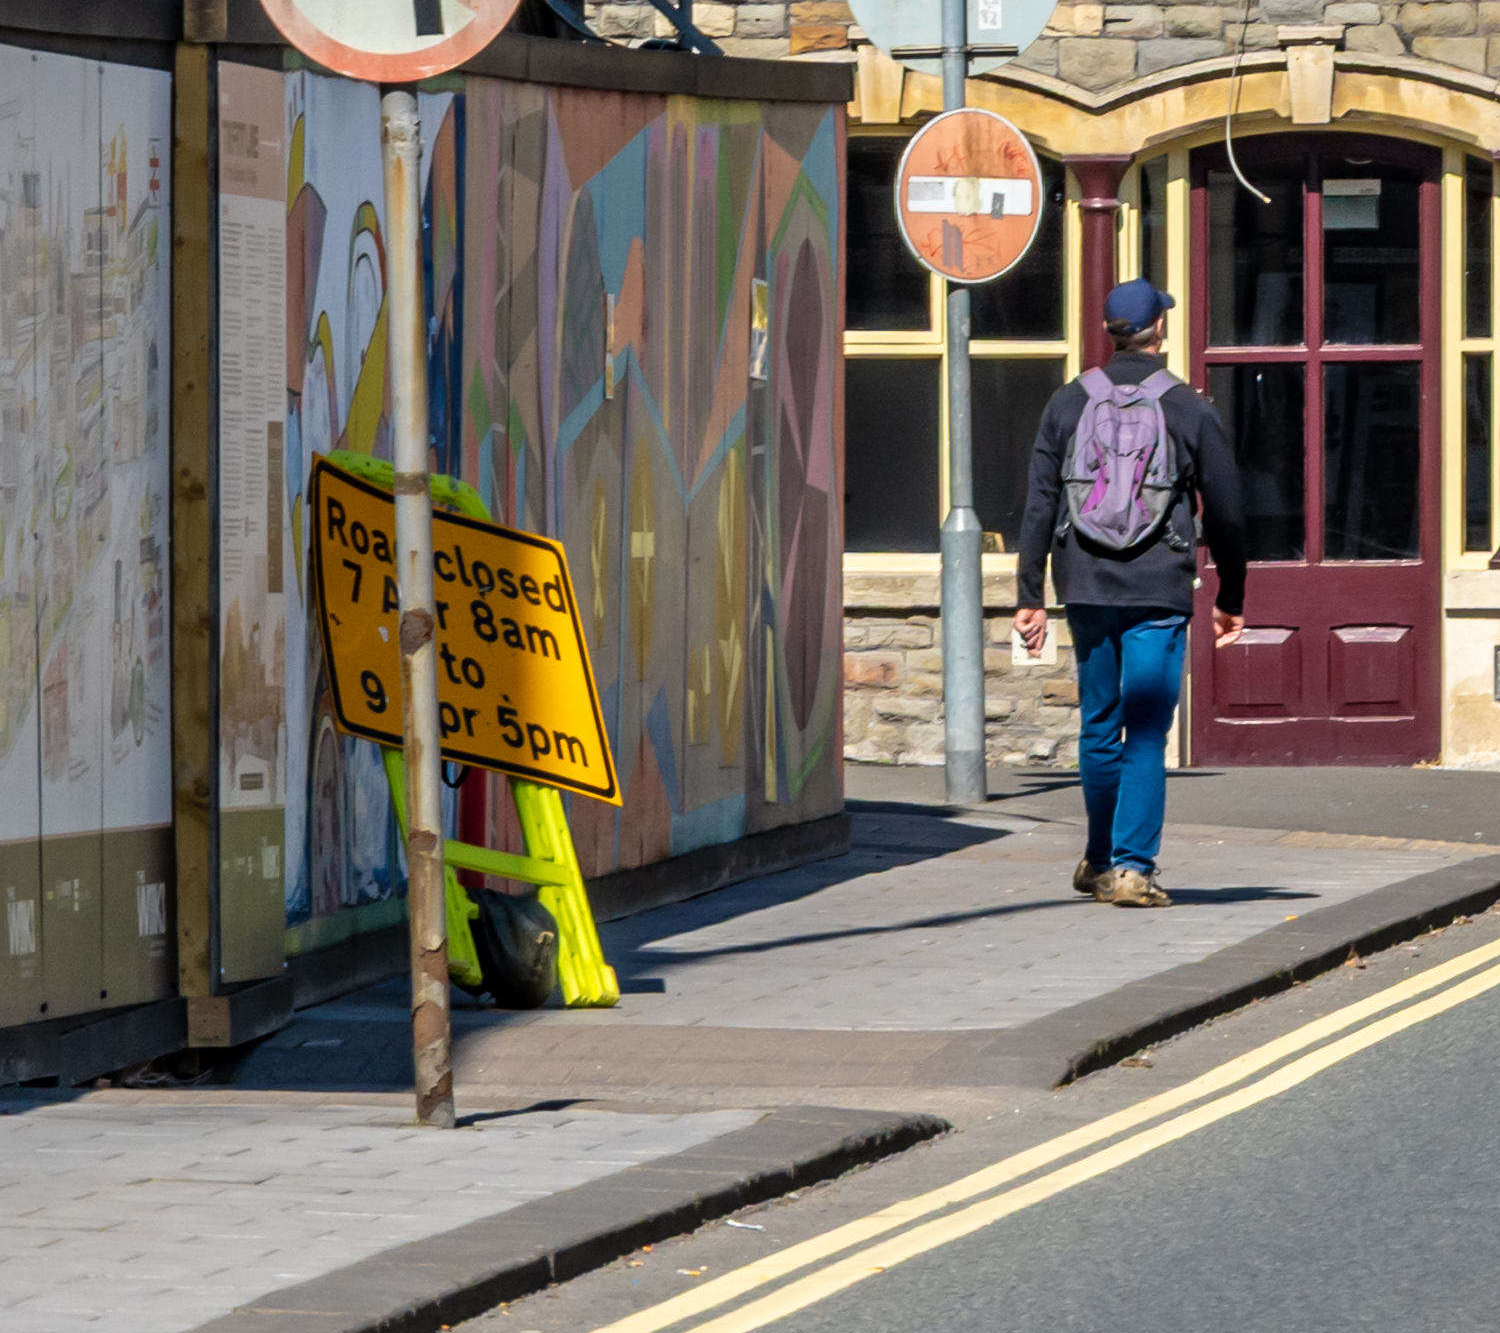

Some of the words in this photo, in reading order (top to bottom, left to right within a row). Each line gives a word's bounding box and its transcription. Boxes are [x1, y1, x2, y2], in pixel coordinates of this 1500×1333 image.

[327, 496, 397, 565] Roa
[434, 544, 567, 614] closed
[343, 559, 362, 603] 7
[382, 575, 449, 631] Ar
[470, 600, 561, 662] 8am
[439, 642, 486, 690] to
[360, 670, 388, 714] 9
[439, 701, 478, 739] pr
[497, 704, 589, 768] 5pm
